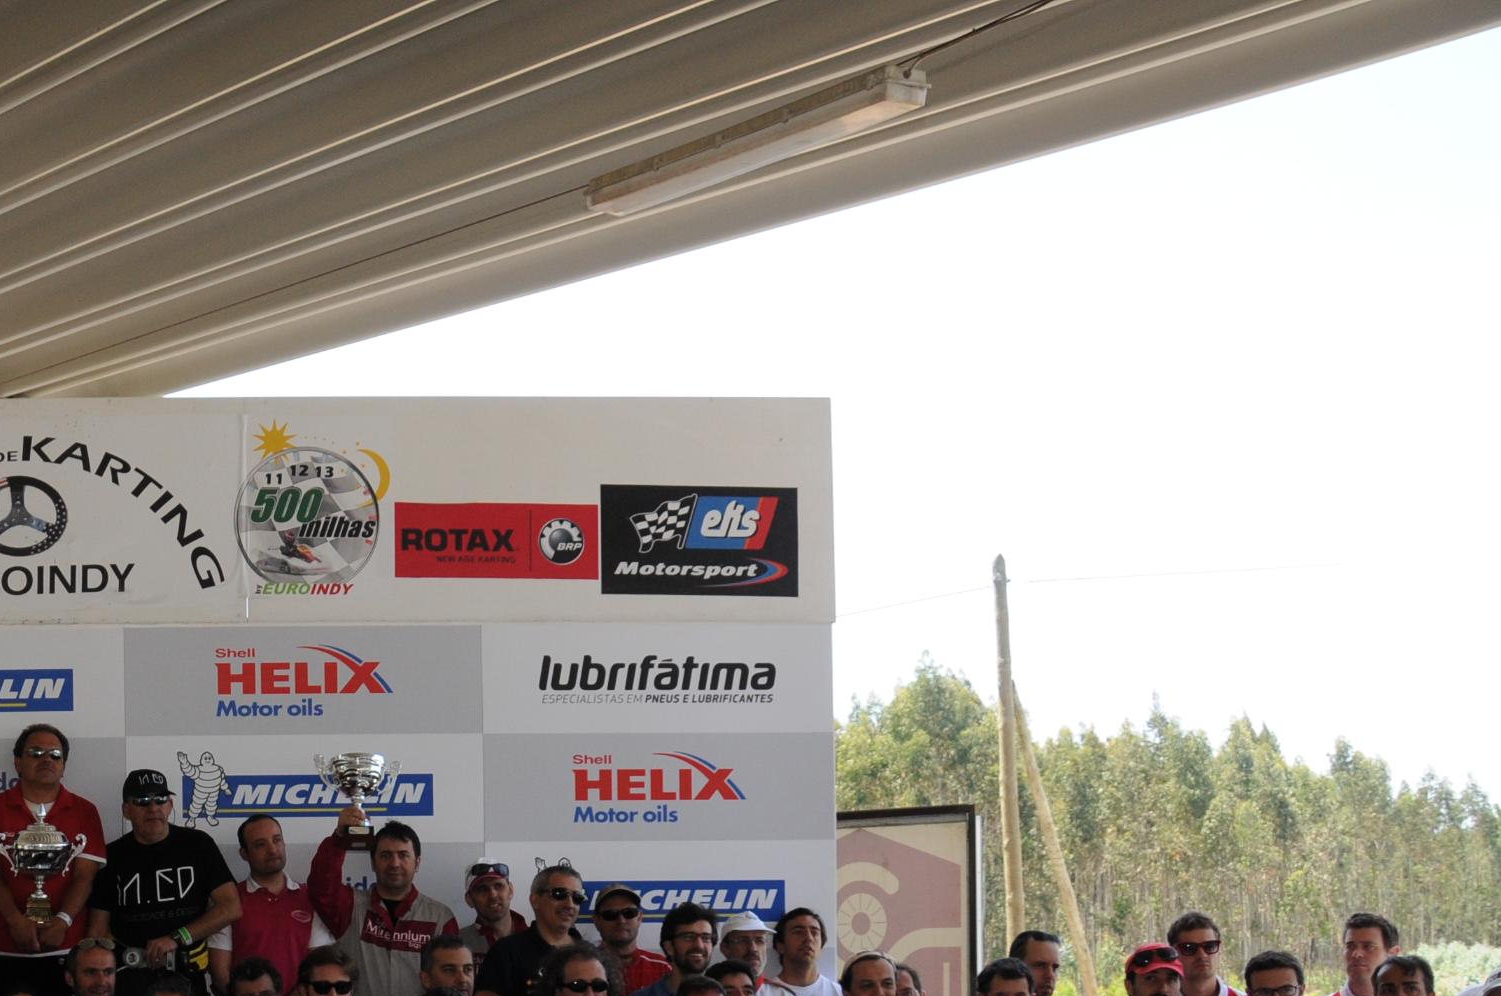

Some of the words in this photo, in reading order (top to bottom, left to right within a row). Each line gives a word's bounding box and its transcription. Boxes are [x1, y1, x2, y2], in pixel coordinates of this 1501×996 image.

[265, 473, 283, 485] 11
[290, 464, 309, 477] 12
[315, 466, 334, 478] 13
[20, 435, 226, 590] KARTING
[250, 487, 325, 524] 500
[299, 516, 376, 538] milhas
[401, 528, 515, 552] ROTAX
[556, 542, 583, 551] BRP
[614, 561, 758, 580] Motorsport
[262, 582, 354, 595] EUROINDY
[215, 648, 256, 658] Shell
[214, 661, 388, 695] HELIX
[538, 655, 777, 691] lubrifátima
[216, 700, 283, 717] Motor
[287, 698, 324, 717] oils
[541, 693, 624, 704] ESPECIALISTAS
[626, 693, 644, 703] EM
[645, 693, 680, 704] PNEUS
[682, 693, 689, 703] E
[691, 693, 774, 704] LUBRIFICANTES
[572, 754, 612, 765] Shell
[572, 768, 740, 801] HELIX
[573, 806, 638, 823] Motor
[642, 804, 679, 822] oils
